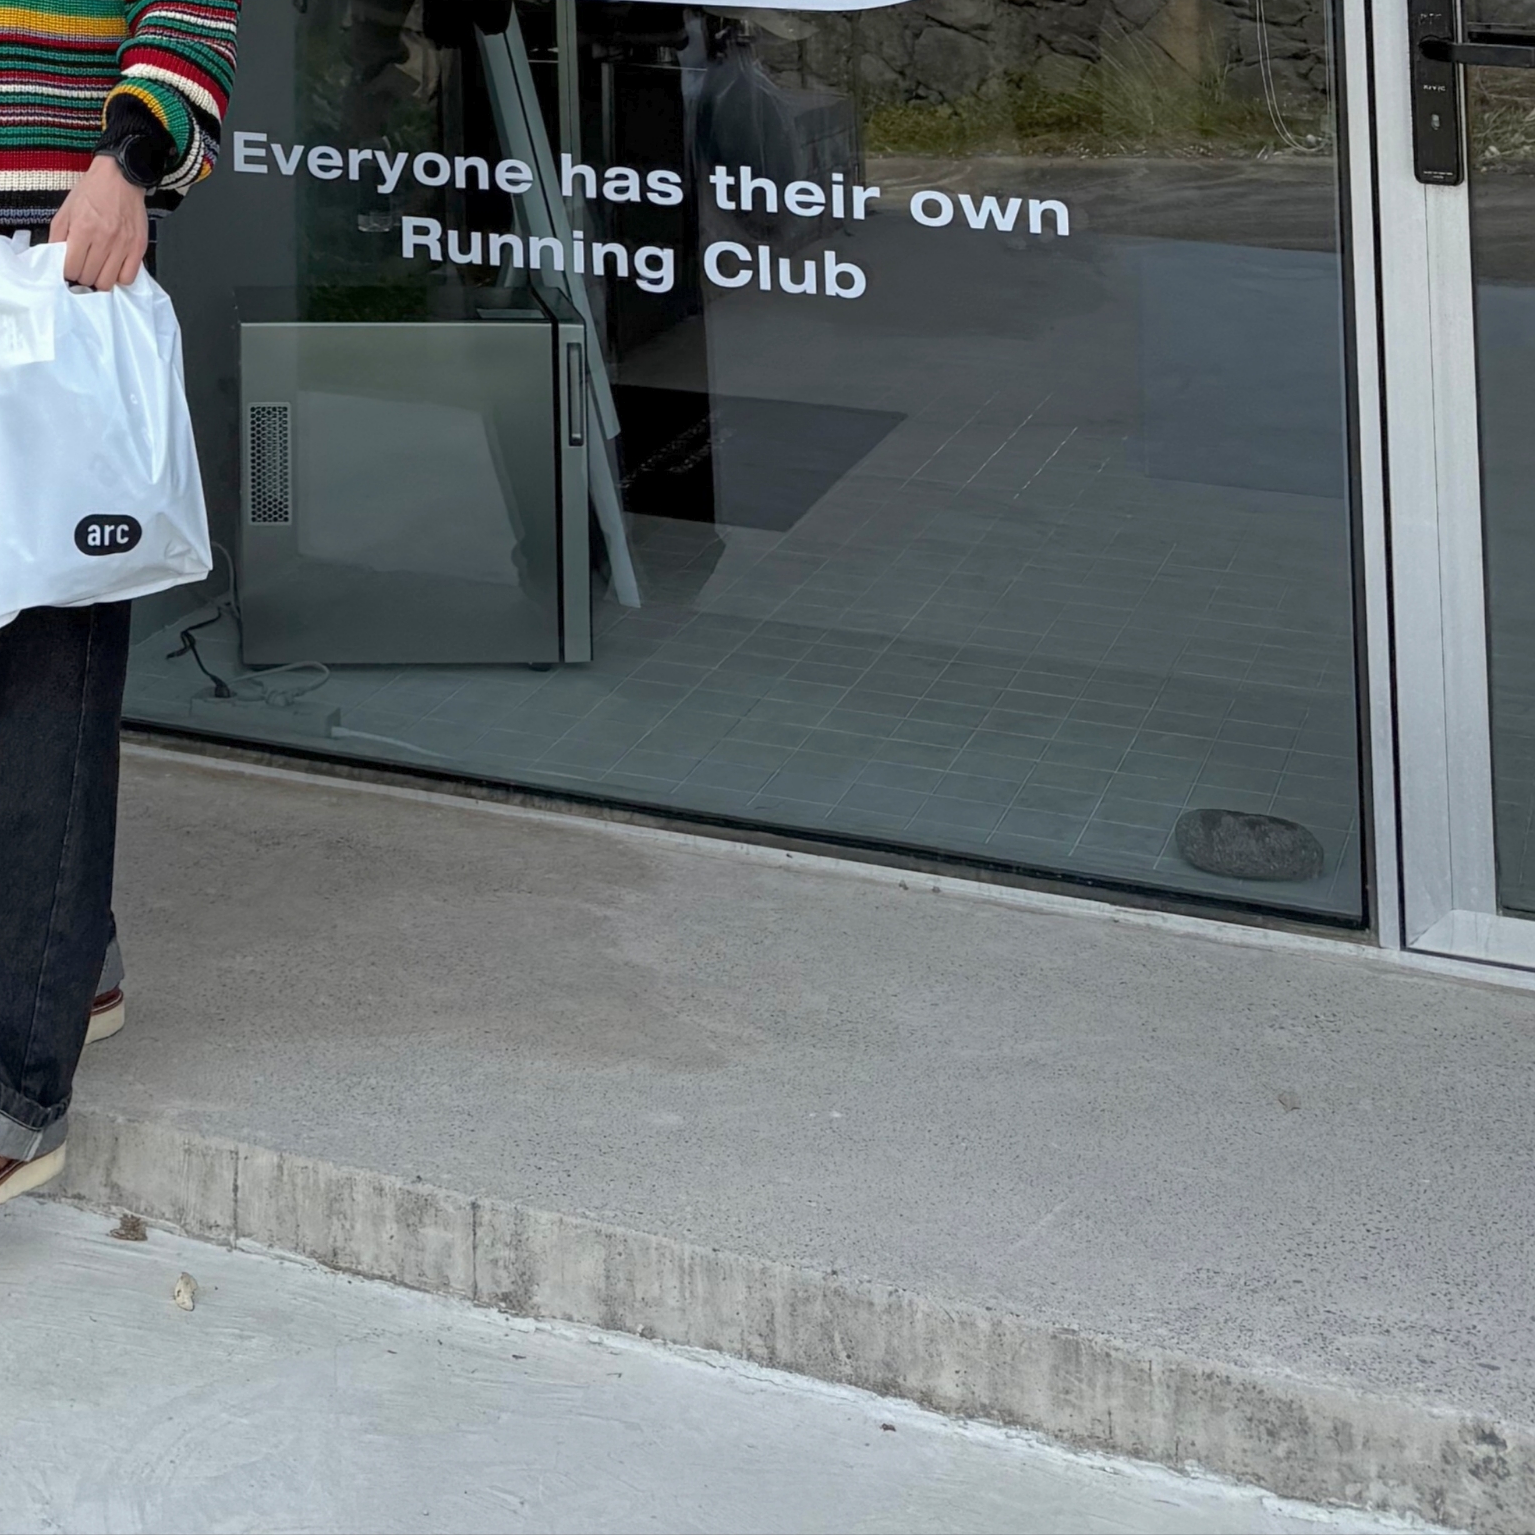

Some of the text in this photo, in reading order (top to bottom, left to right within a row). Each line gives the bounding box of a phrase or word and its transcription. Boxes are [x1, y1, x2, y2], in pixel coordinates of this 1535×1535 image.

[233, 130, 1071, 237] Everyone has their own
[401, 215, 867, 299] Running Club
[87, 524, 130, 546] arc
